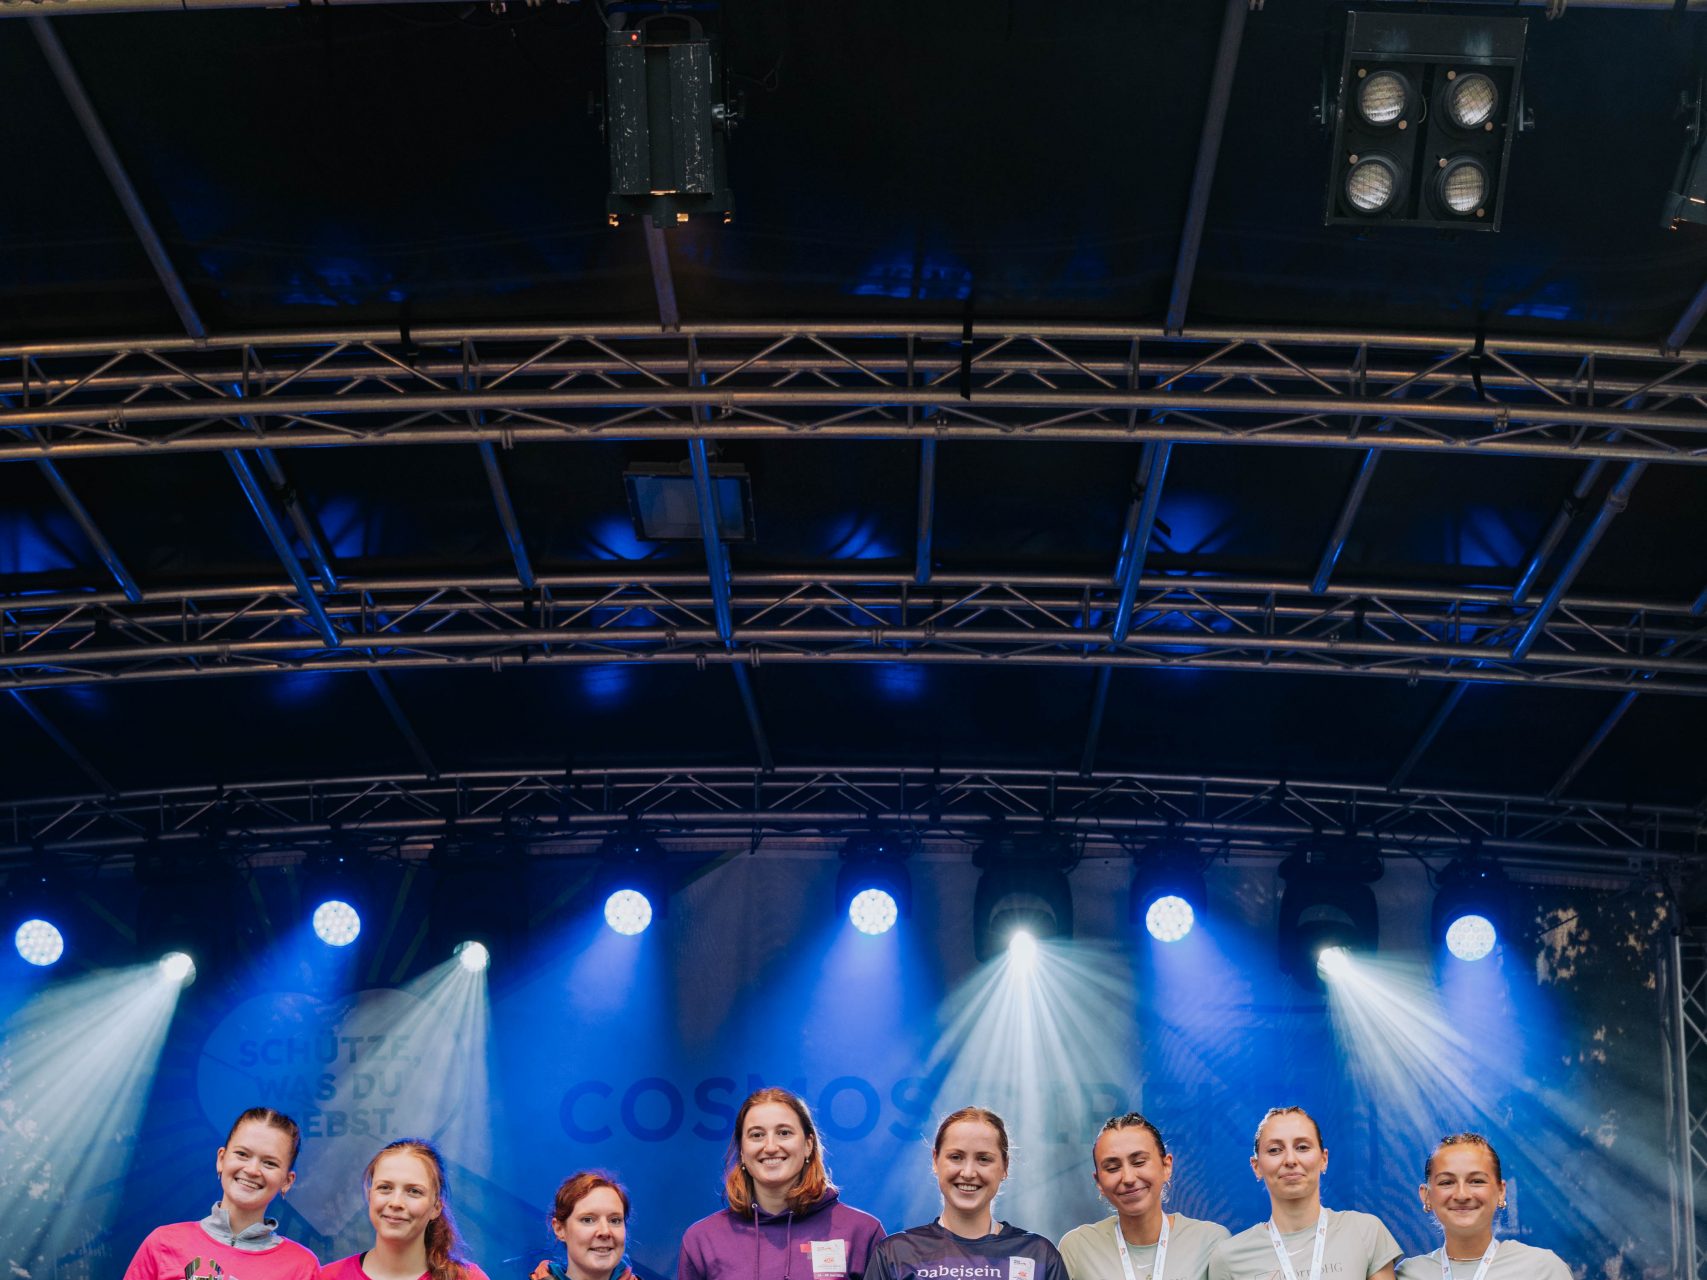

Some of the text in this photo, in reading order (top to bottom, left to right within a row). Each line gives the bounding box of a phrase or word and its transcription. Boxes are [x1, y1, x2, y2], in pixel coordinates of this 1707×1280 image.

[240, 1029, 422, 1069] SCHÜTZE,
[256, 1072, 401, 1102] WAS DU
[290, 1107, 399, 1138] EBST.
[559, 1073, 938, 1144] COSOS
